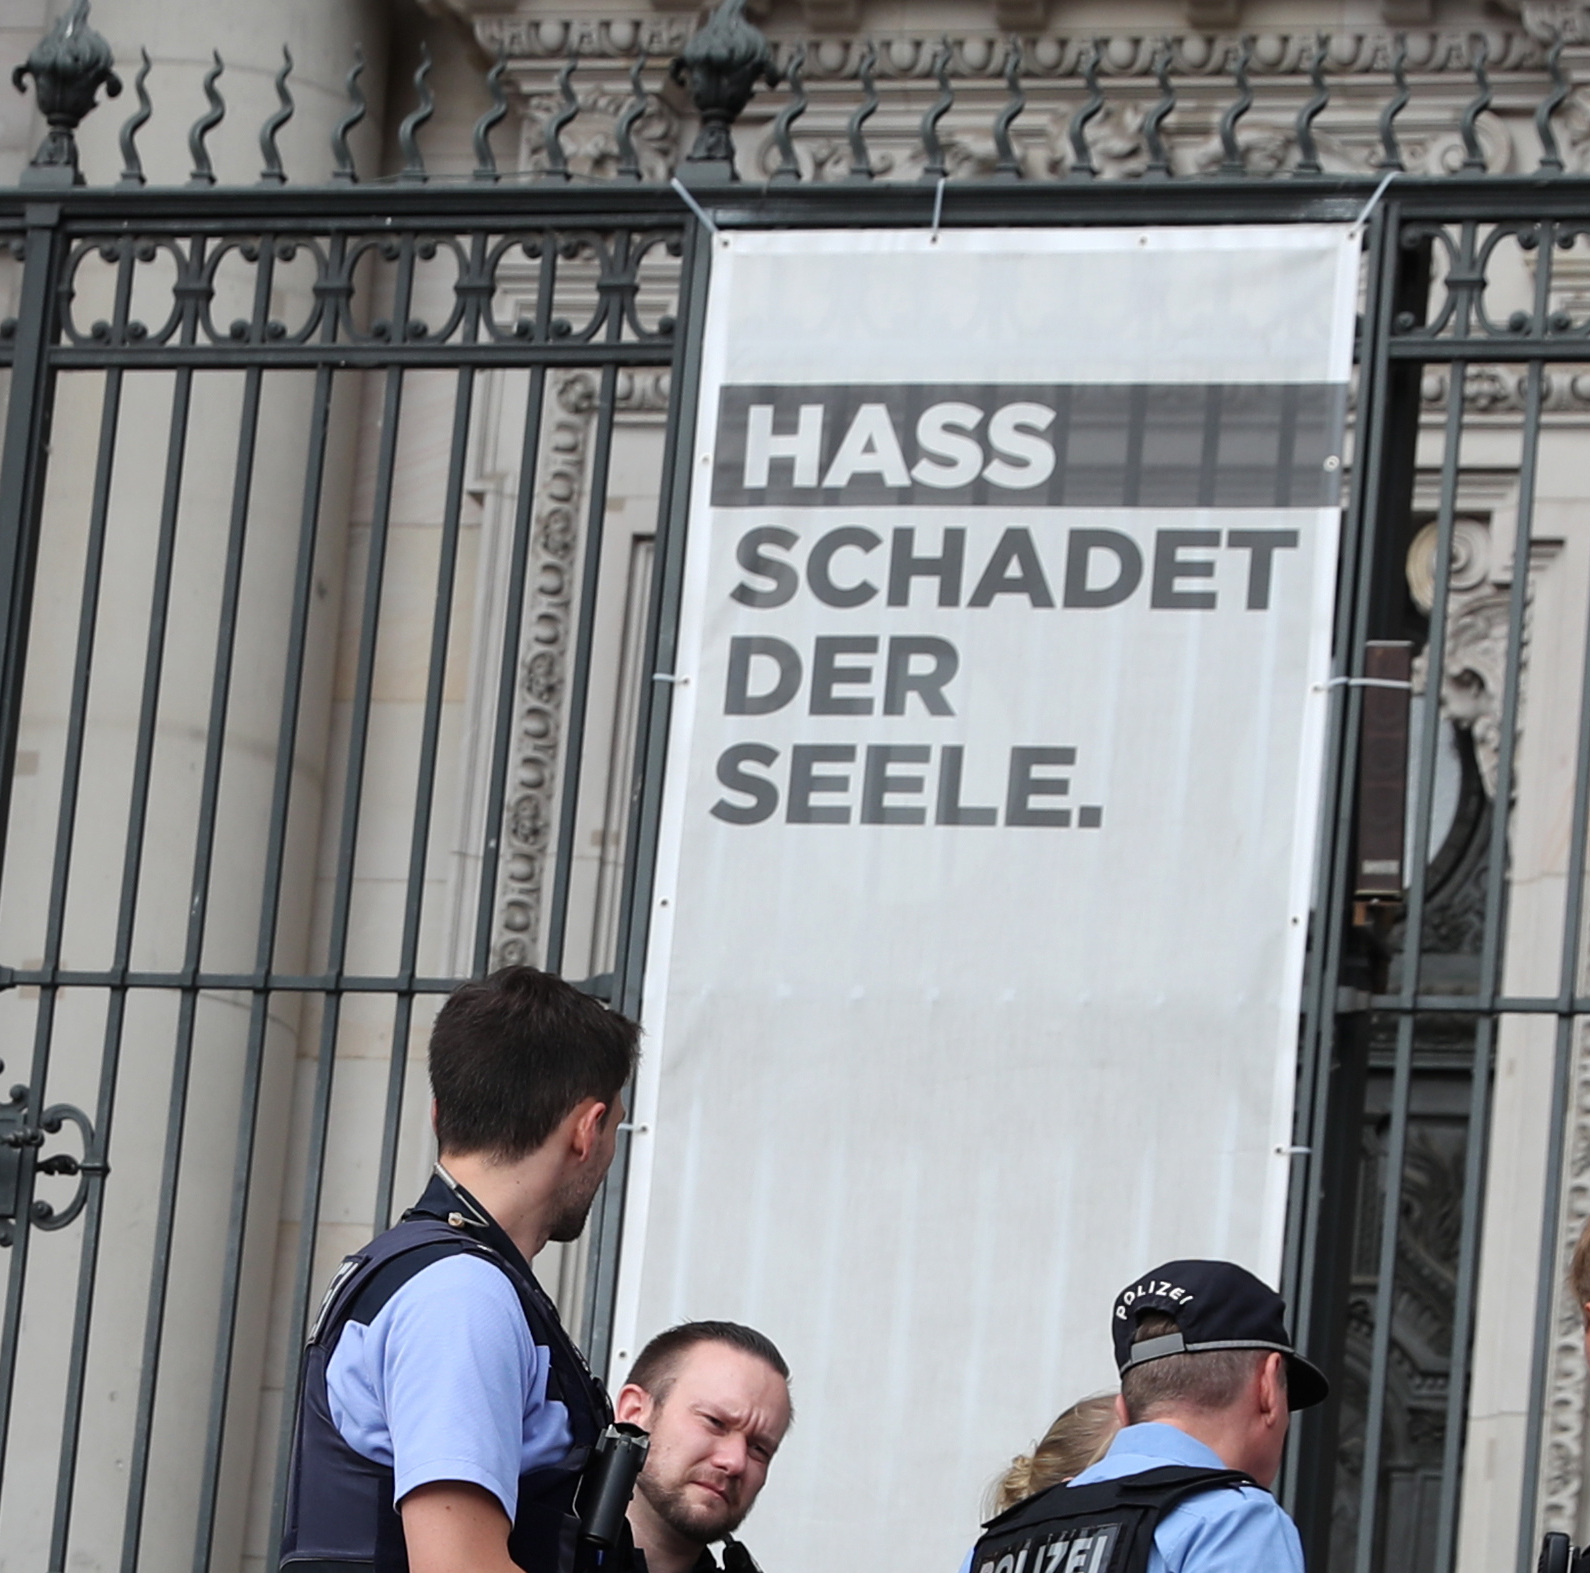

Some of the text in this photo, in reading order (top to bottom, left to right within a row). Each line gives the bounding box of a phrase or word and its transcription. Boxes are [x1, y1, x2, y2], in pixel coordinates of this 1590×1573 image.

[742, 402, 1057, 490] HASS
[729, 526, 1299, 611] SCHADET
[723, 636, 960, 717] DER
[708, 742, 1105, 829] SEELE.
[1116, 1280, 1194, 1320] POLIZEI
